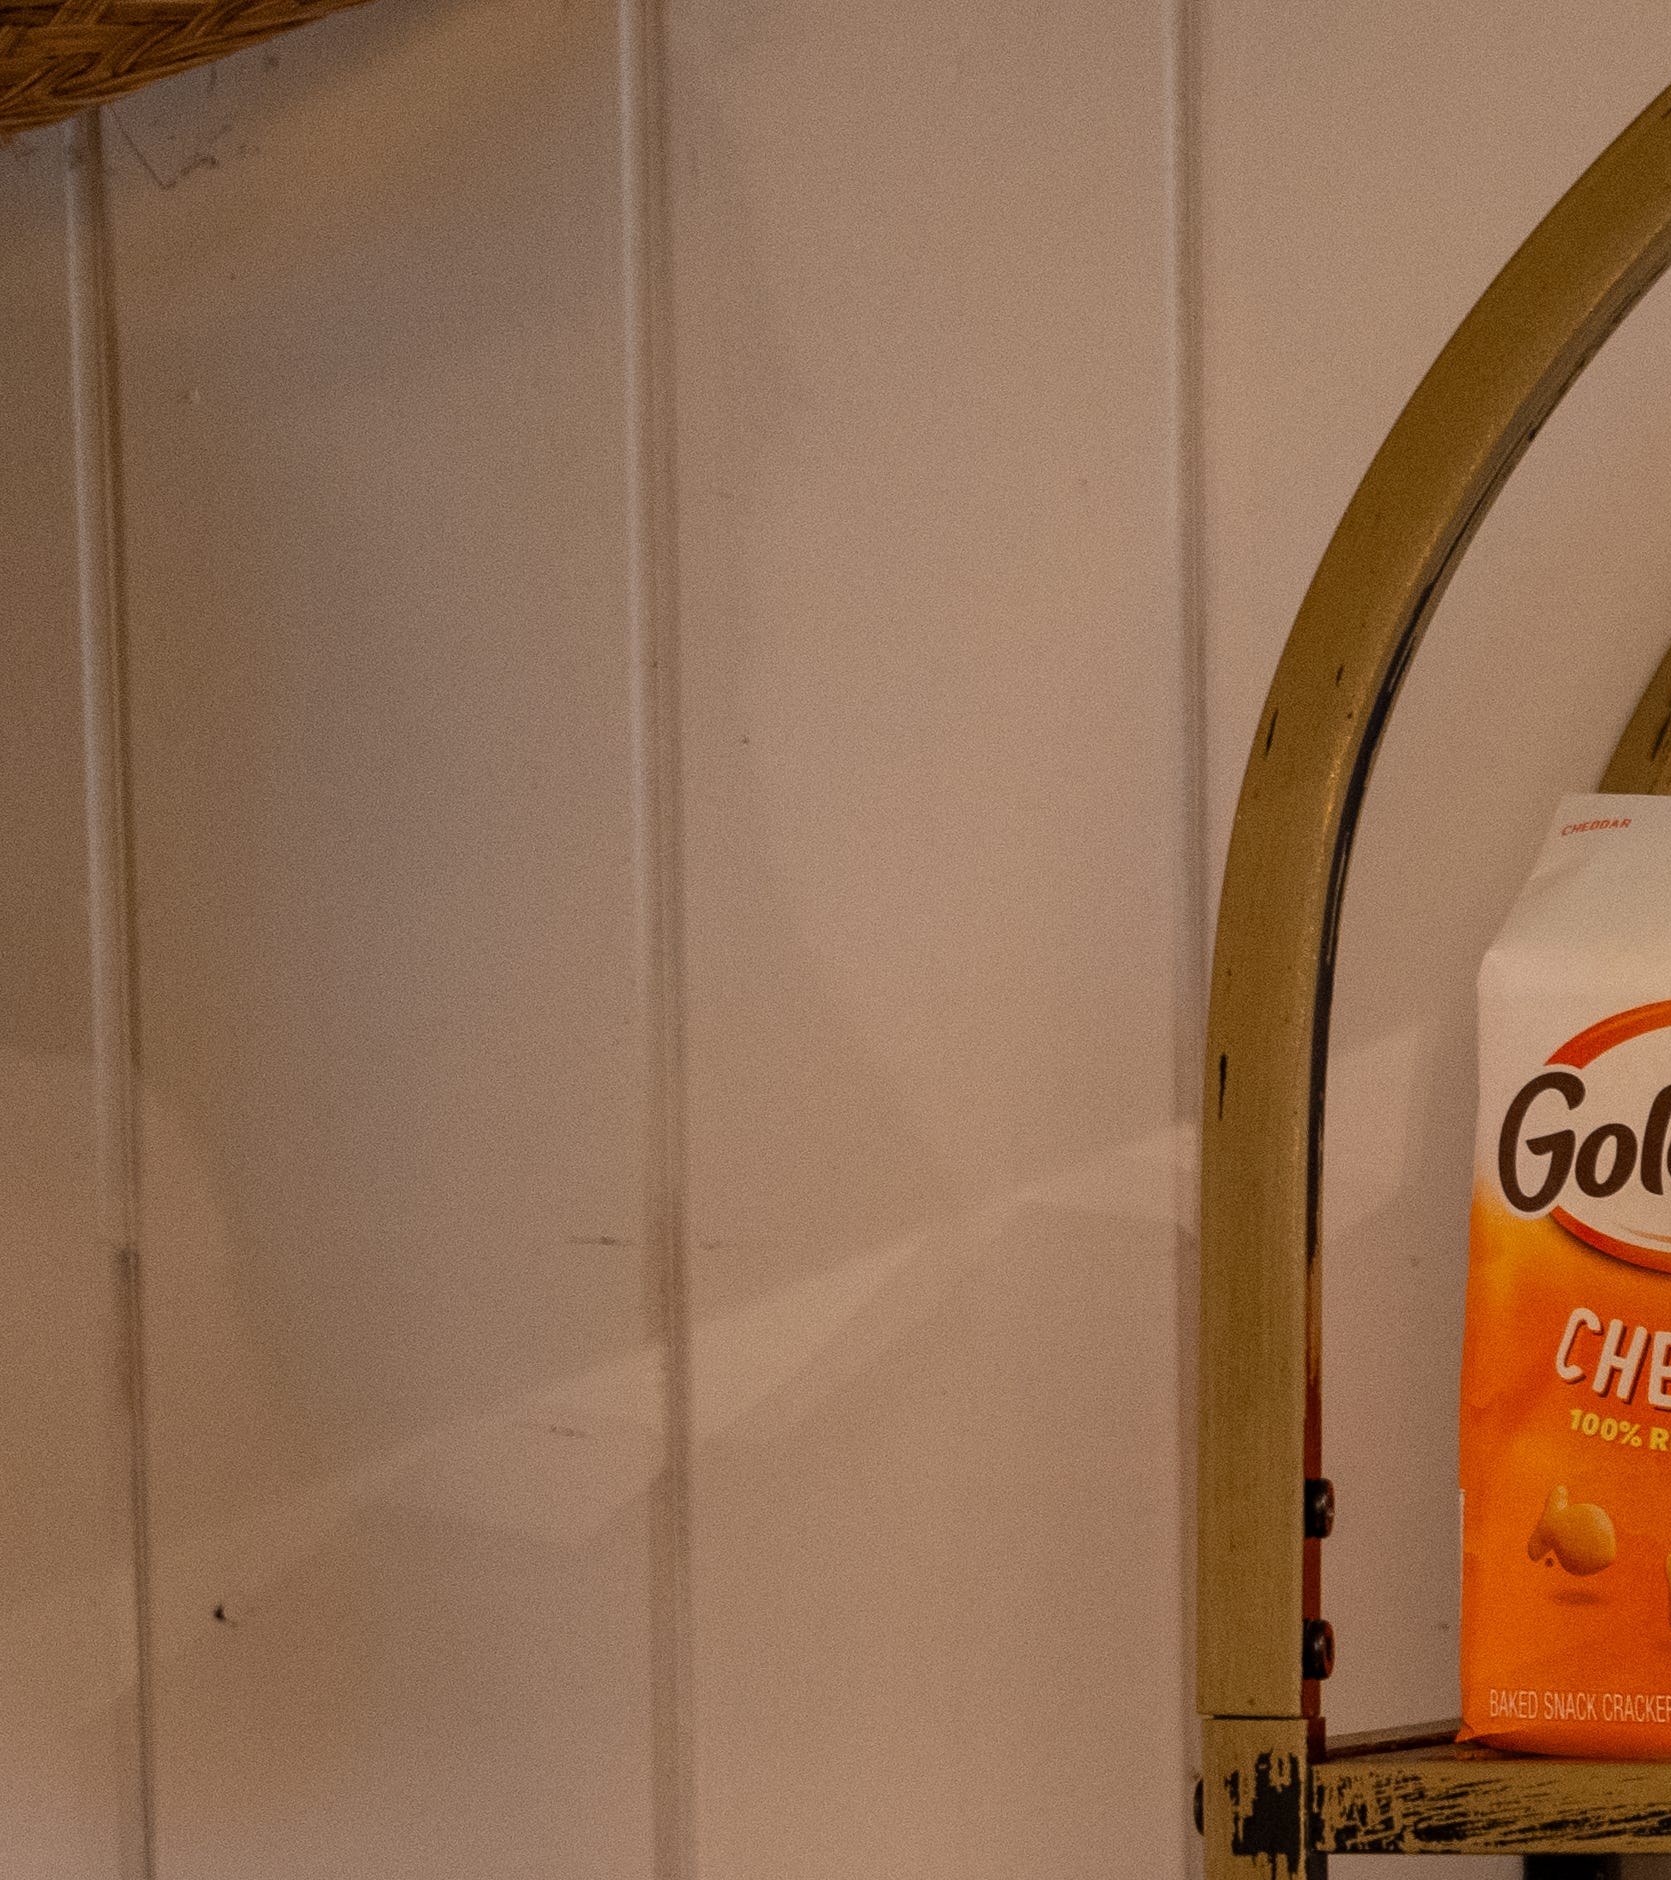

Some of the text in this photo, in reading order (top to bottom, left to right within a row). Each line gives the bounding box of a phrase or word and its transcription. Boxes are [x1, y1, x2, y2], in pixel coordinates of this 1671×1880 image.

[1561, 818, 1632, 837] CHEDDAR
[1569, 1409, 1642, 1447] 100%
[1490, 1689, 1538, 1719] BAKED
[1544, 1691, 1597, 1722] SNACK
